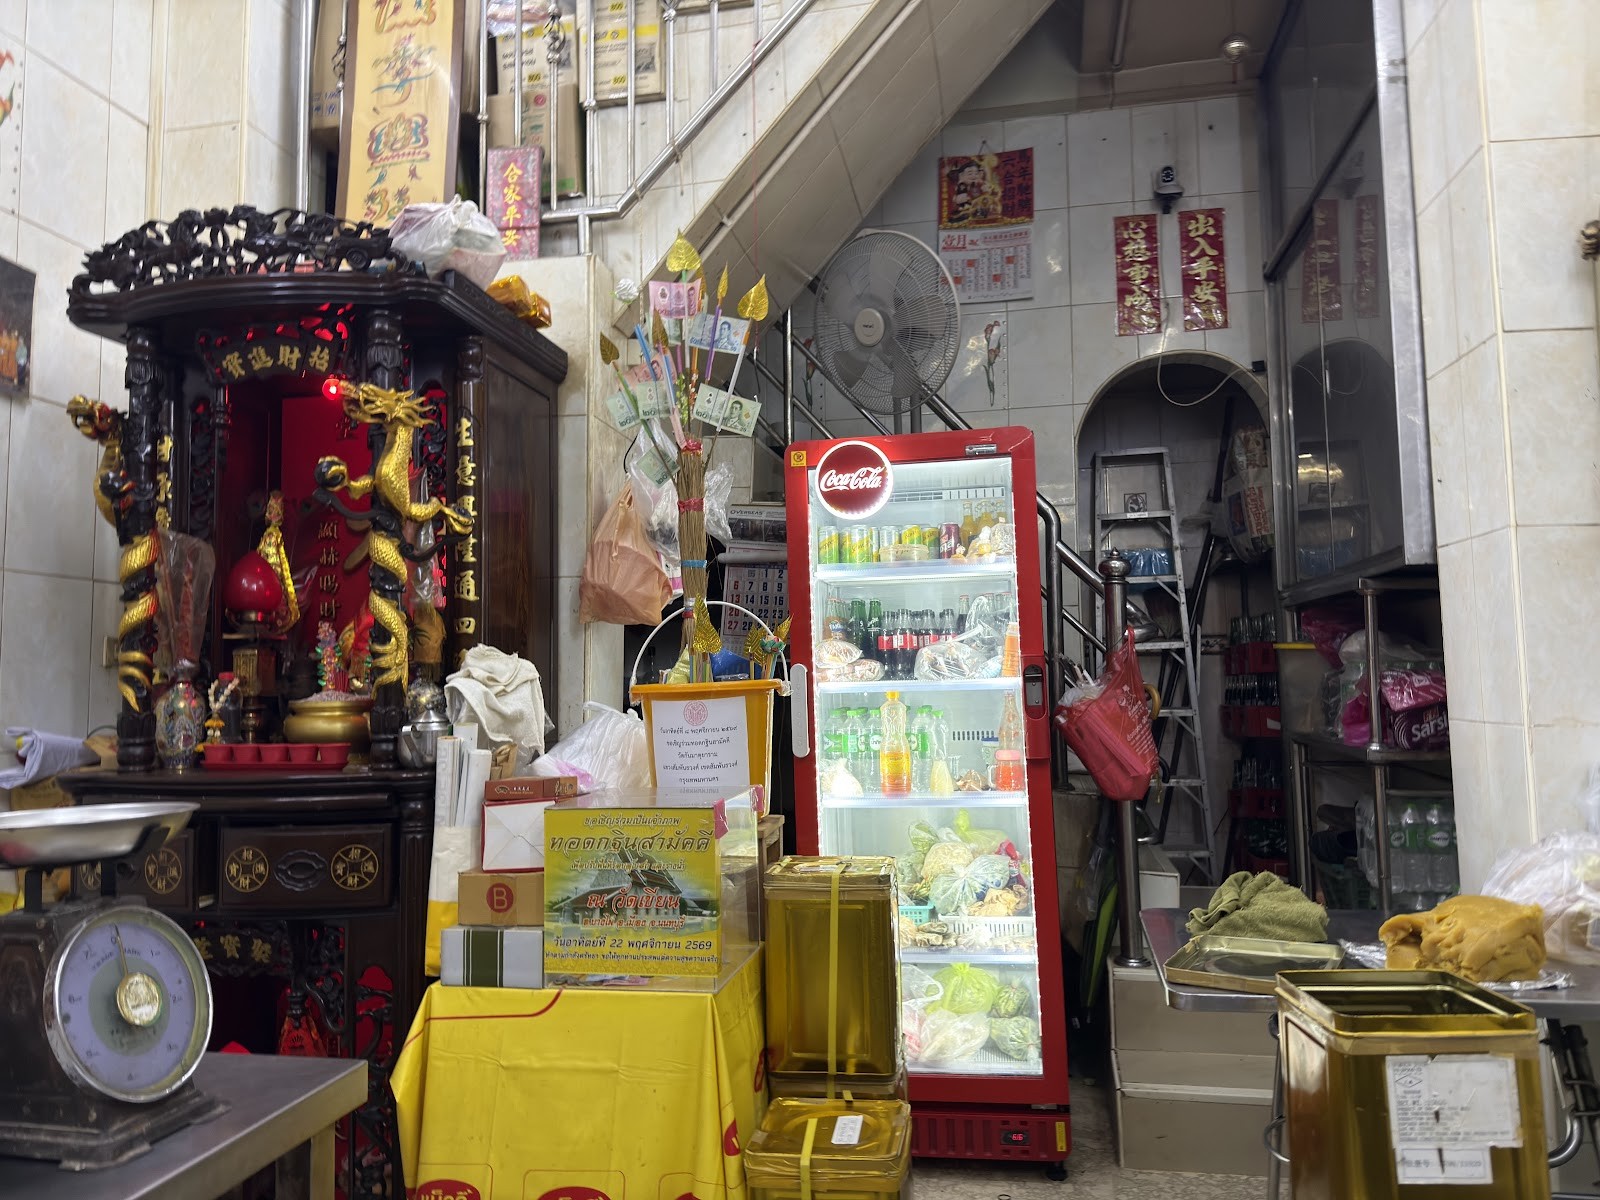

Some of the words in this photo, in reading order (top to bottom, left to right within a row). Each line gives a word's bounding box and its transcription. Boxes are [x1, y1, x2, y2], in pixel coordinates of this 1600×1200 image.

[502, 162, 522, 246] 合家平安
[1188, 214, 1220, 303] 出入平安
[820, 466, 885, 492] Coca-Cola
[764, 569, 768, 578] 1
[778, 570, 783, 579] 2
[734, 581, 739, 590] 6
[748, 582, 754, 590] 7
[763, 582, 768, 591] 8
[777, 583, 782, 592] 9
[731, 594, 740, 604] 13
[745, 595, 754, 604] 14
[760, 595, 769, 605] 15
[774, 596, 784, 605] 16
[758, 609, 769, 618] 22
[773, 610, 783, 619] 23
[728, 621, 739, 630] 27
[584, 813, 681, 828] ขอเชิญร่วมเป็นเจ้าภาพ
[549, 826, 714, 857] ทอดกฐินสามัคคี
[493, 887, 507, 910] B
[611, 883, 681, 914] วัดเขียน
[553, 934, 607, 948] วันอาทิตย์ที่
[610, 939, 623, 948] 22
[627, 937, 681, 951] พฤศจิกายน
[685, 940, 712, 950] 2569
